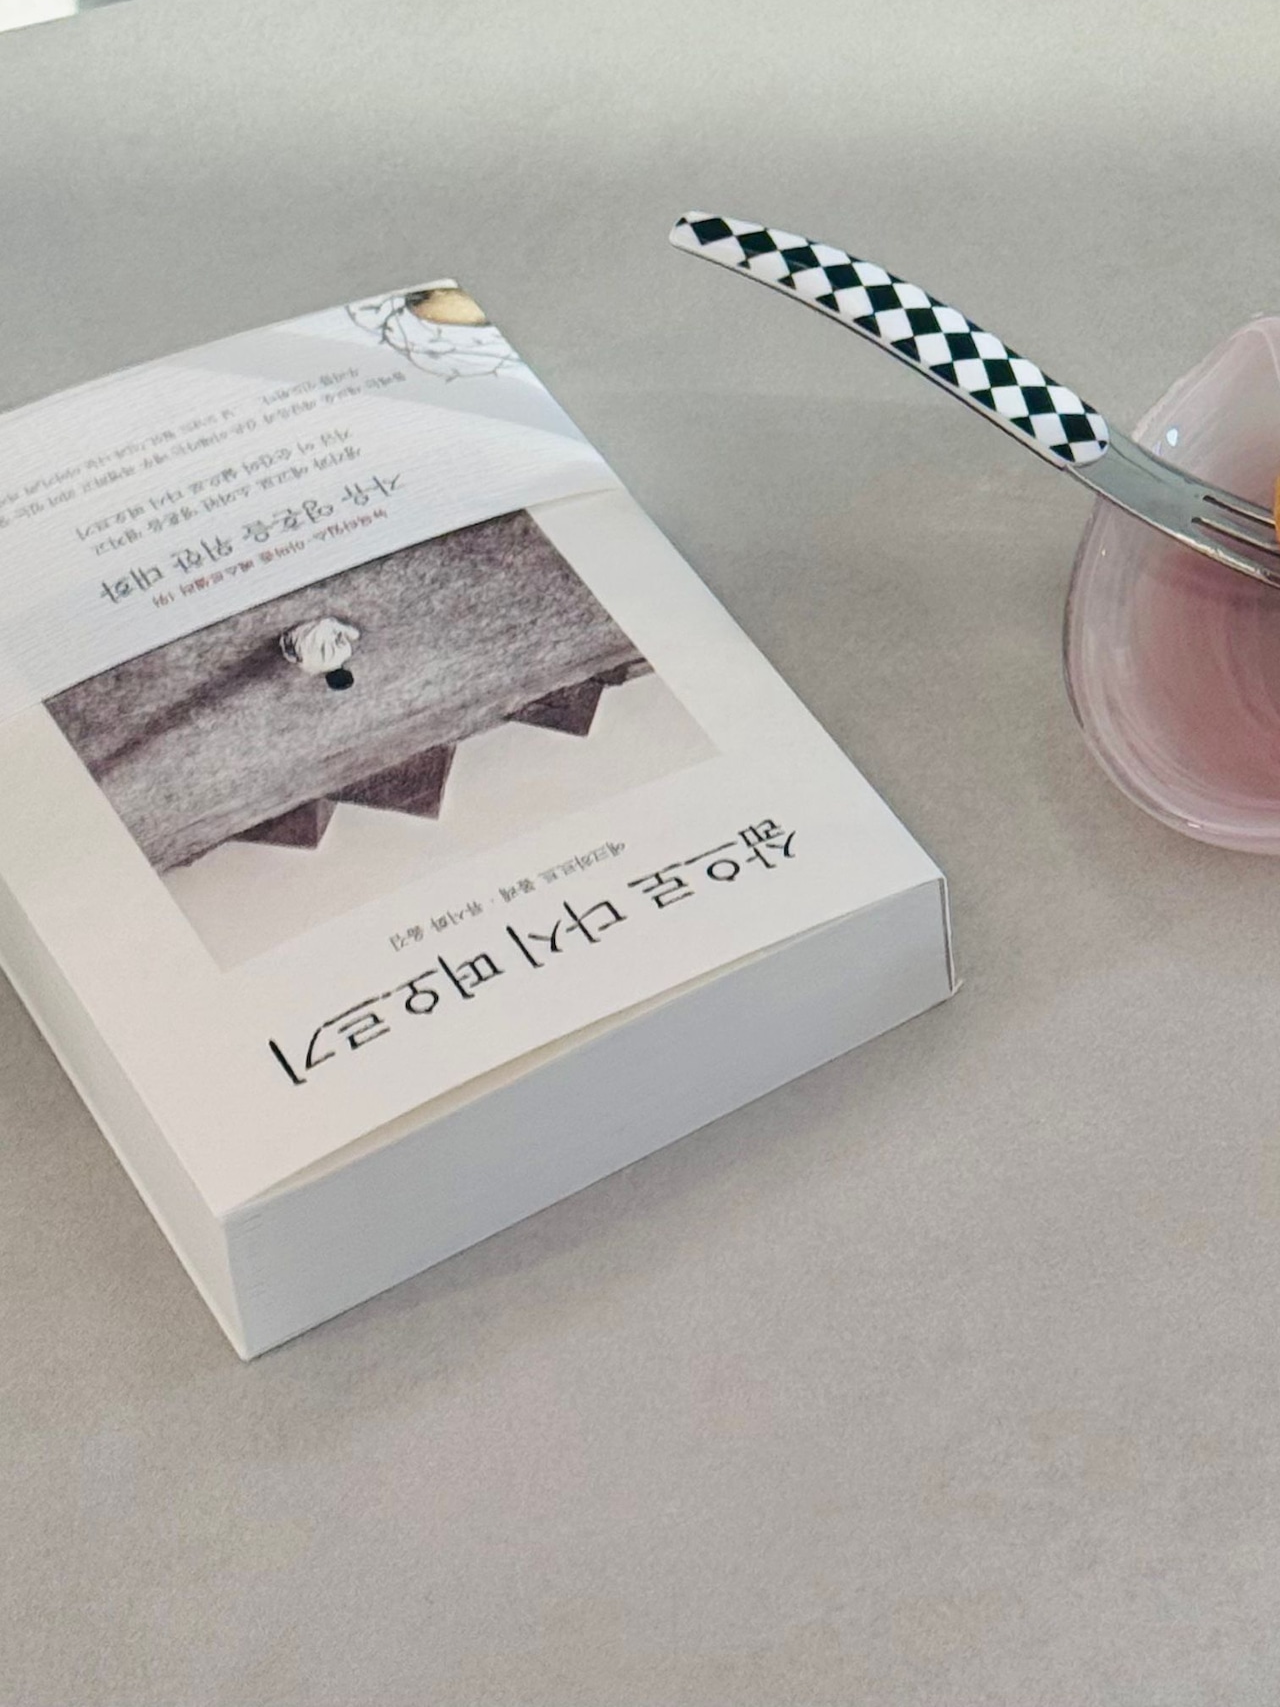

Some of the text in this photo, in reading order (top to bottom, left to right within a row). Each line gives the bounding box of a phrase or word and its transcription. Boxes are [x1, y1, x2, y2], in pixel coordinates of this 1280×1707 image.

[100, 474, 404, 604] 자유 영혼을 위한 대화
[269, 819, 795, 1085] 삶으로 다시 떠오르기
